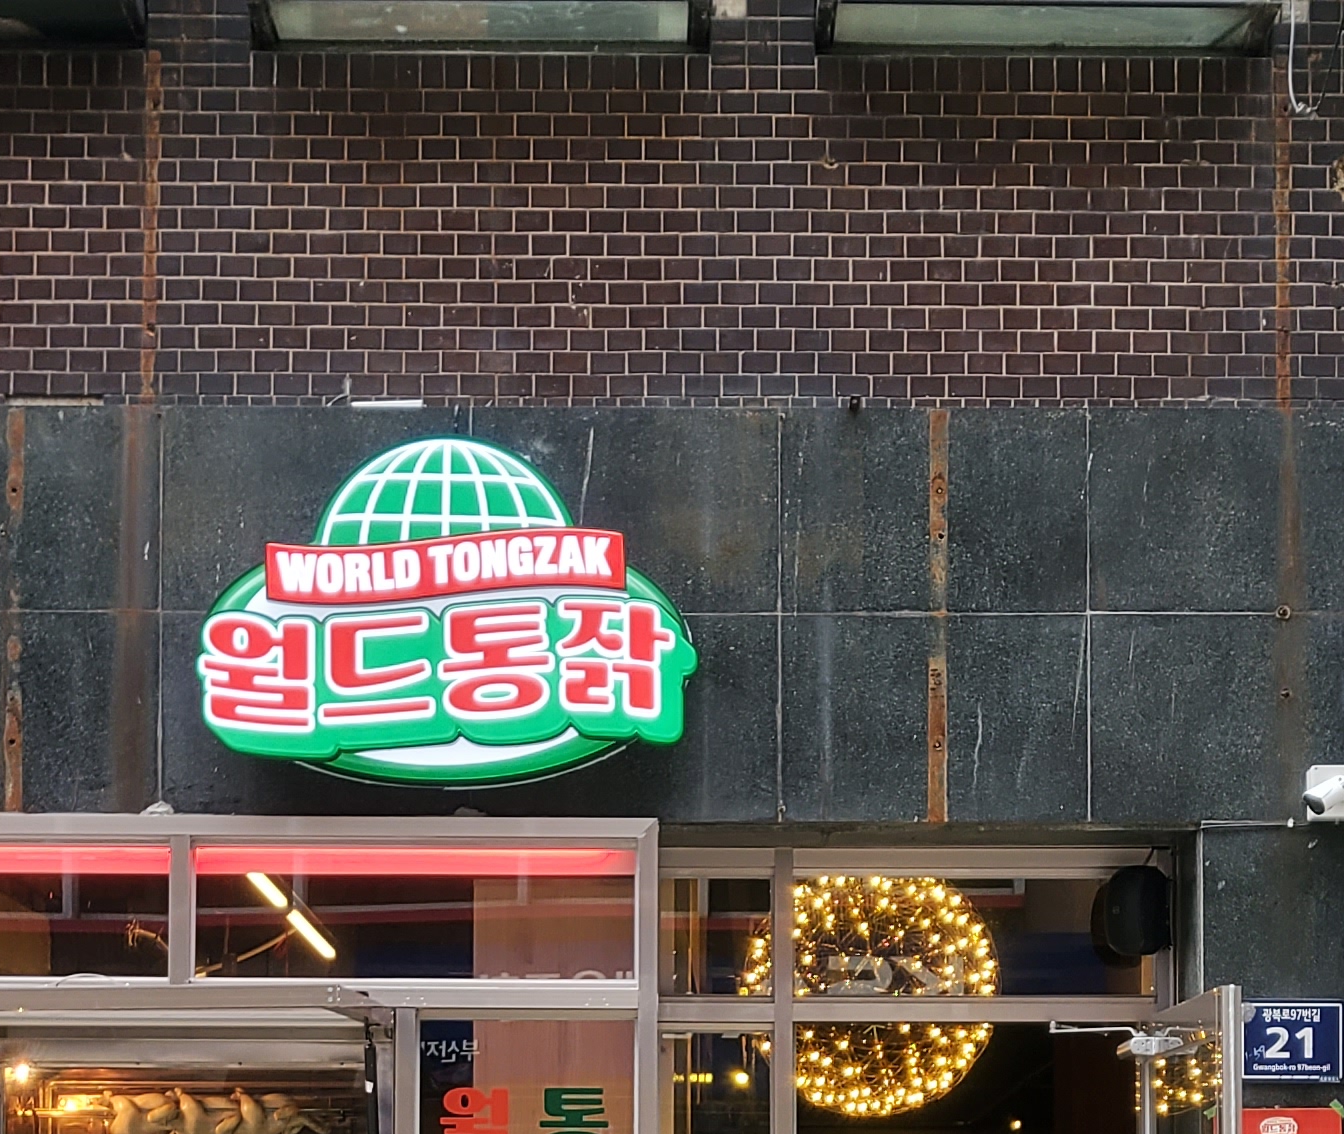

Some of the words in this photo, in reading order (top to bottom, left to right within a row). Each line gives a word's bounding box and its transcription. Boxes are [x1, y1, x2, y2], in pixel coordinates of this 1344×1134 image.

[275, 548, 420, 594] WORLD
[429, 535, 613, 585] TONGZAK
[202, 599, 677, 734] 월드통잙
[1262, 1008, 1321, 1023] 광복로97번길
[1264, 1026, 1314, 1059] 21
[1253, 1063, 1296, 1073] Gwangbok-ro
